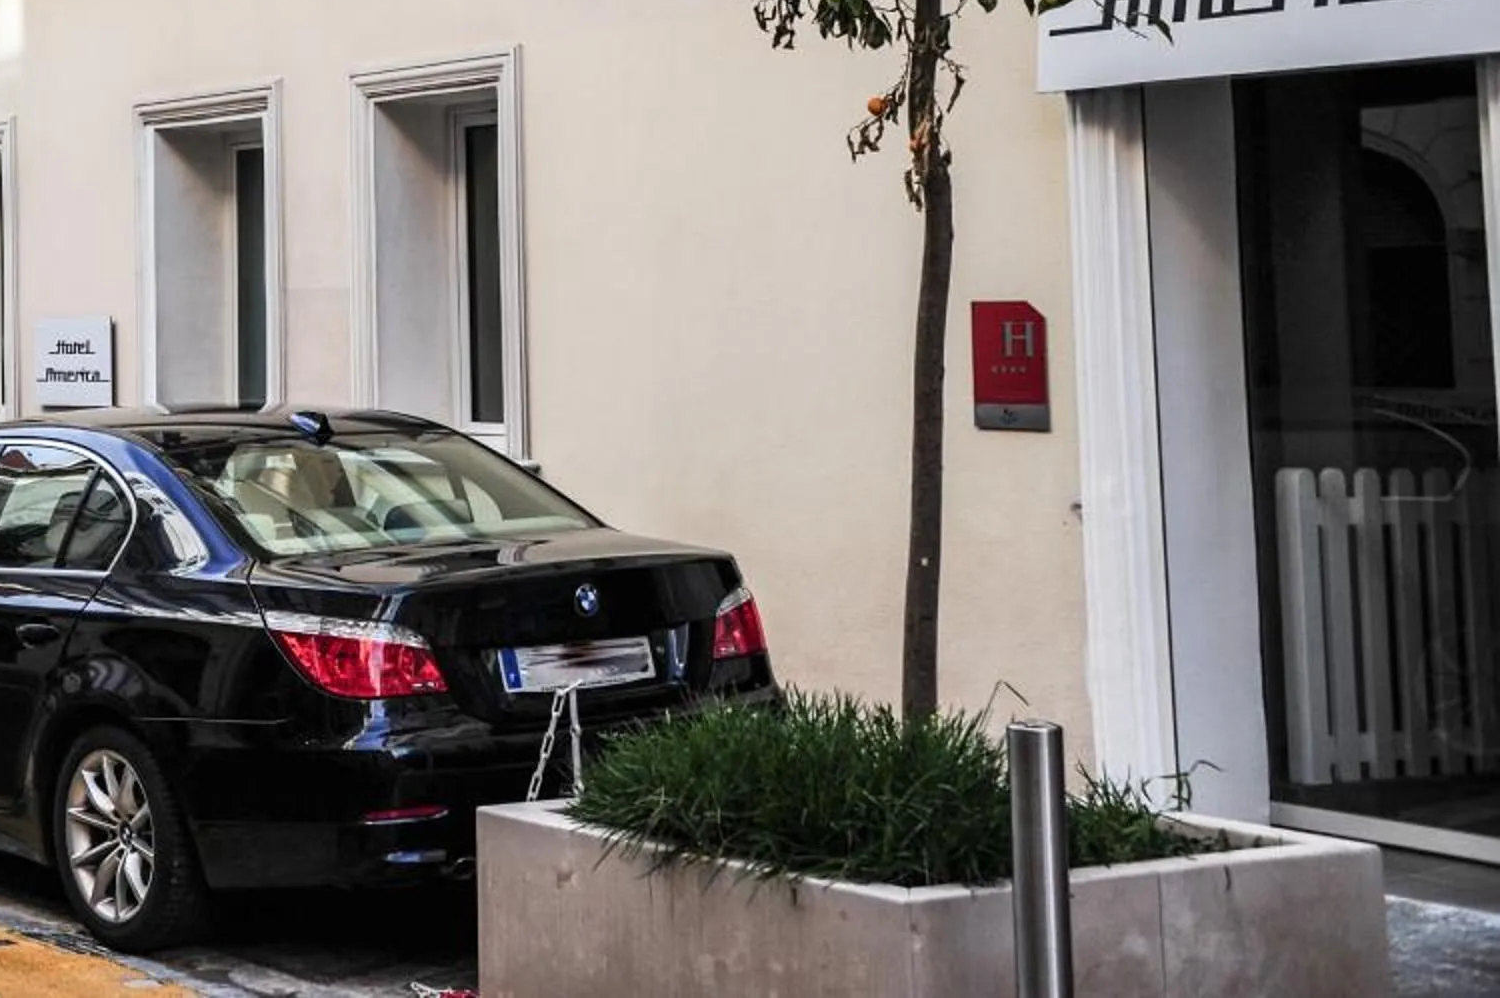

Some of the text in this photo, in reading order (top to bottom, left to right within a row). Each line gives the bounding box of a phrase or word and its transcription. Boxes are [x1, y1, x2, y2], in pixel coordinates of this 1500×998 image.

[48, 339, 96, 355] Hotel
[1002, 321, 1034, 357] H
[36, 367, 111, 383] America
